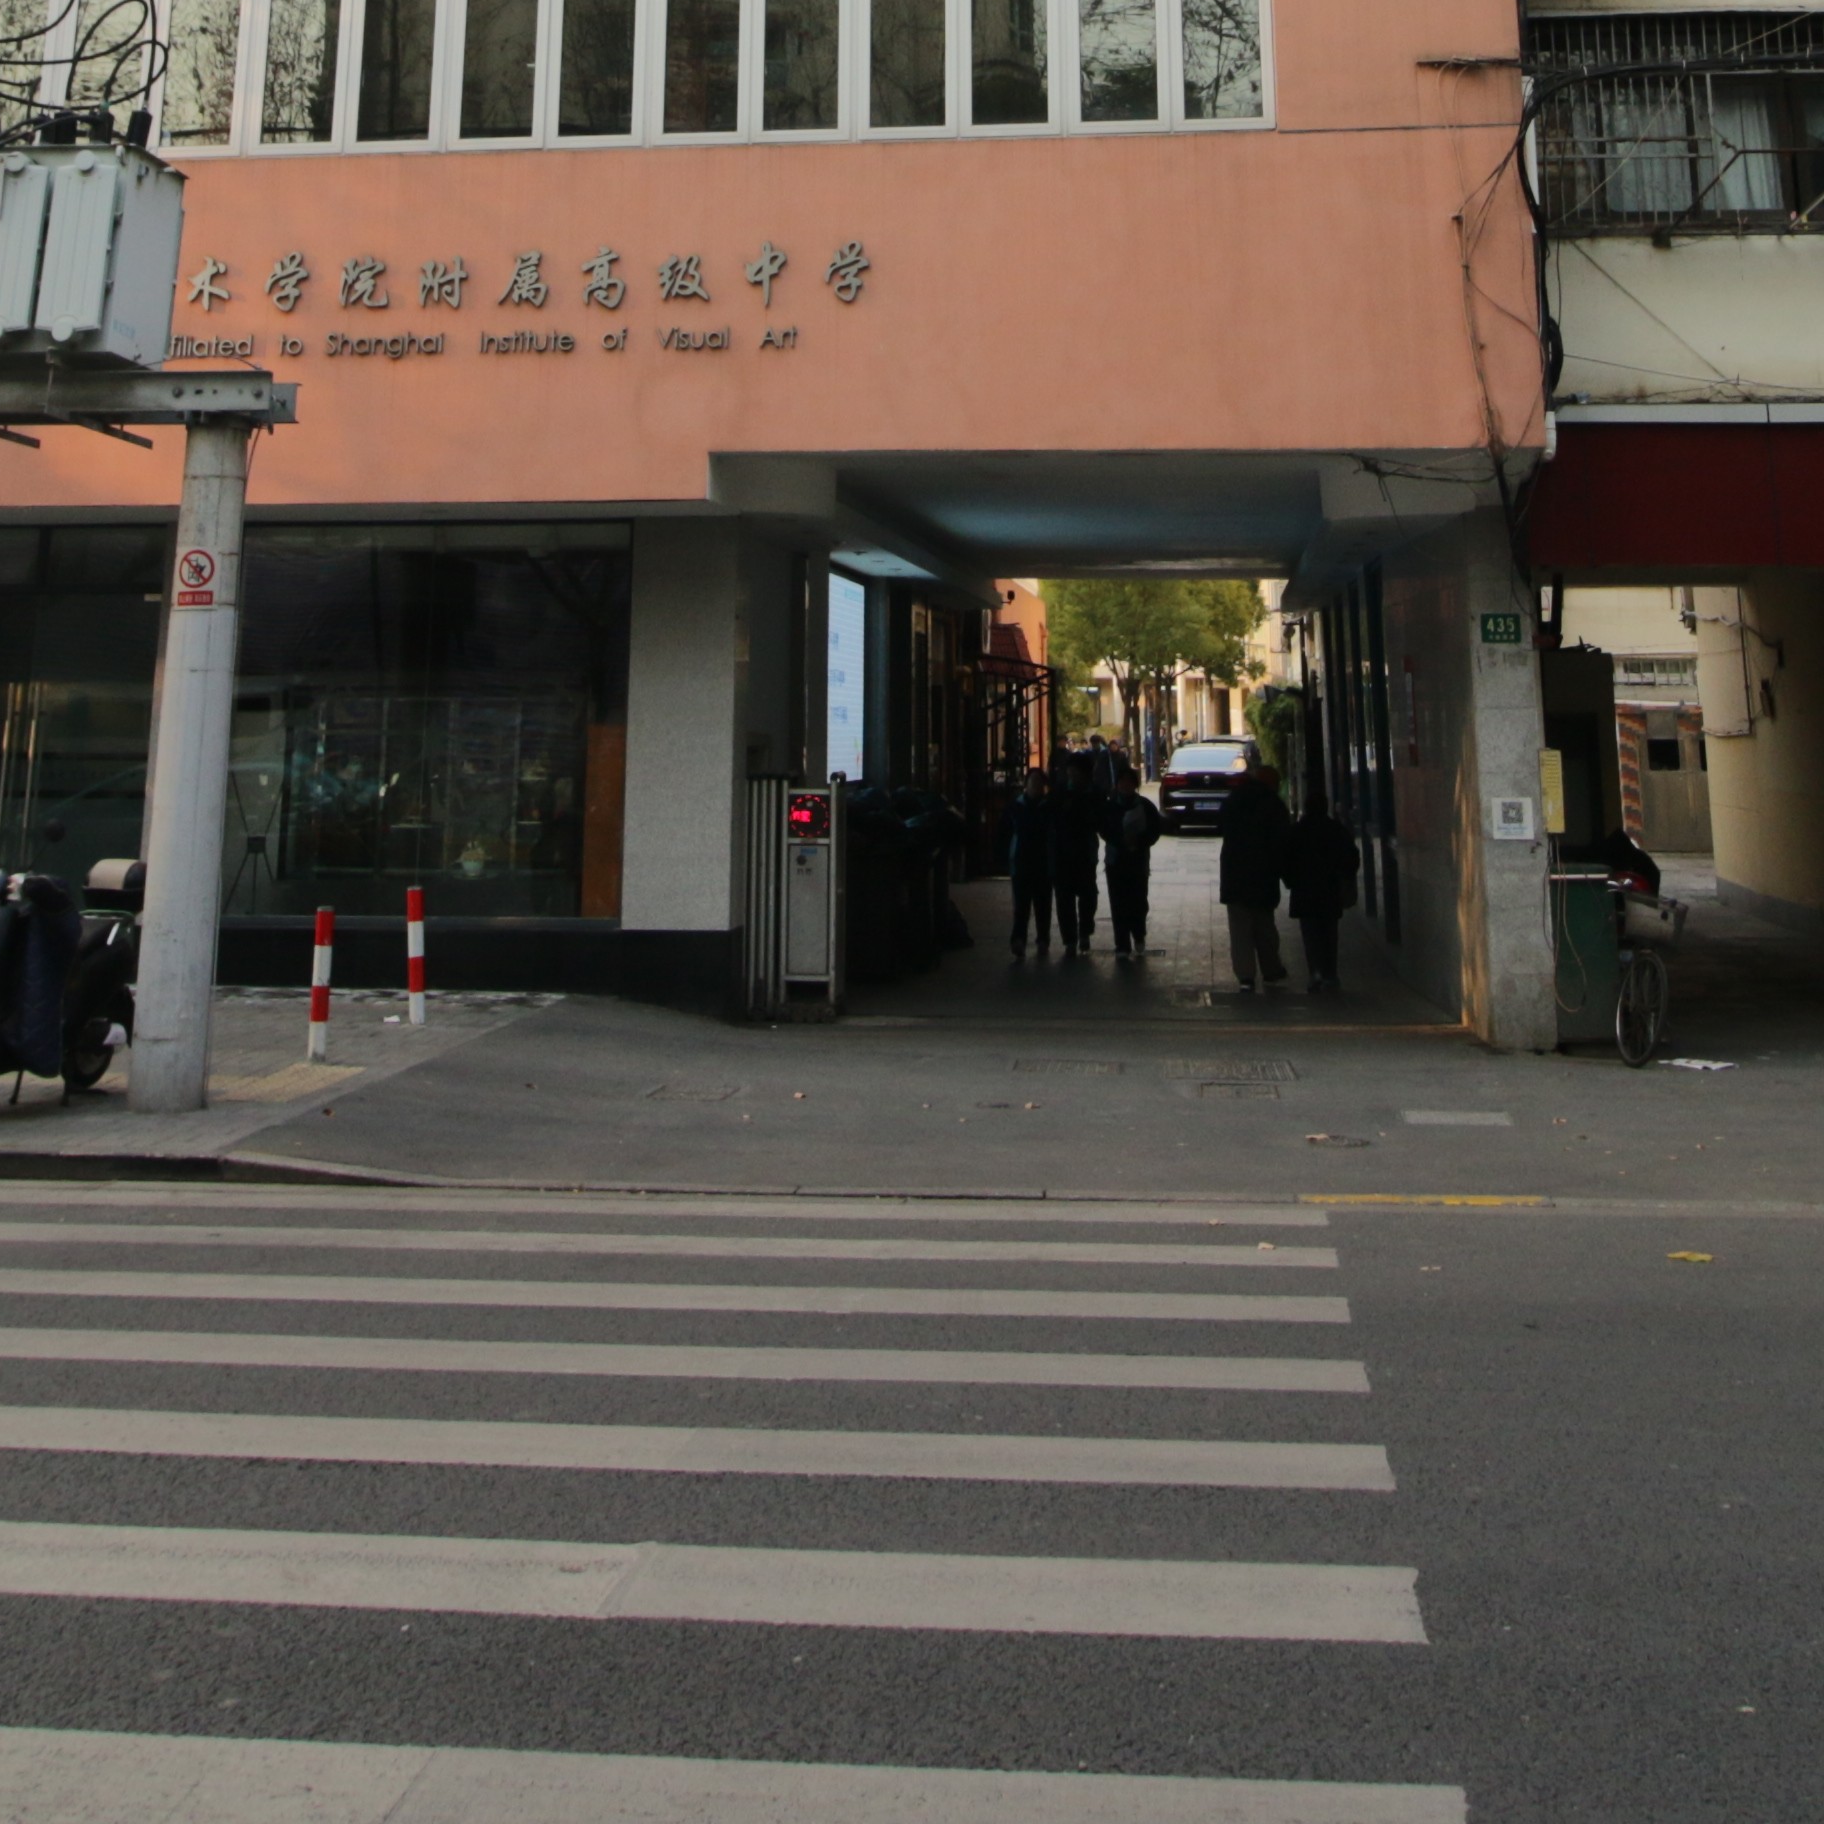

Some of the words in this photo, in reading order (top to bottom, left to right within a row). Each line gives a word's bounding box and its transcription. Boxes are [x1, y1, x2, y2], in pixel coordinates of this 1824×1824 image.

[279, 334, 304, 356] to
[326, 330, 446, 361] Shanghai
[480, 328, 576, 354] Institute
[602, 326, 629, 352] of
[658, 325, 731, 351] Visual
[759, 325, 799, 350] Art
[1486, 617, 1516, 633] 435
